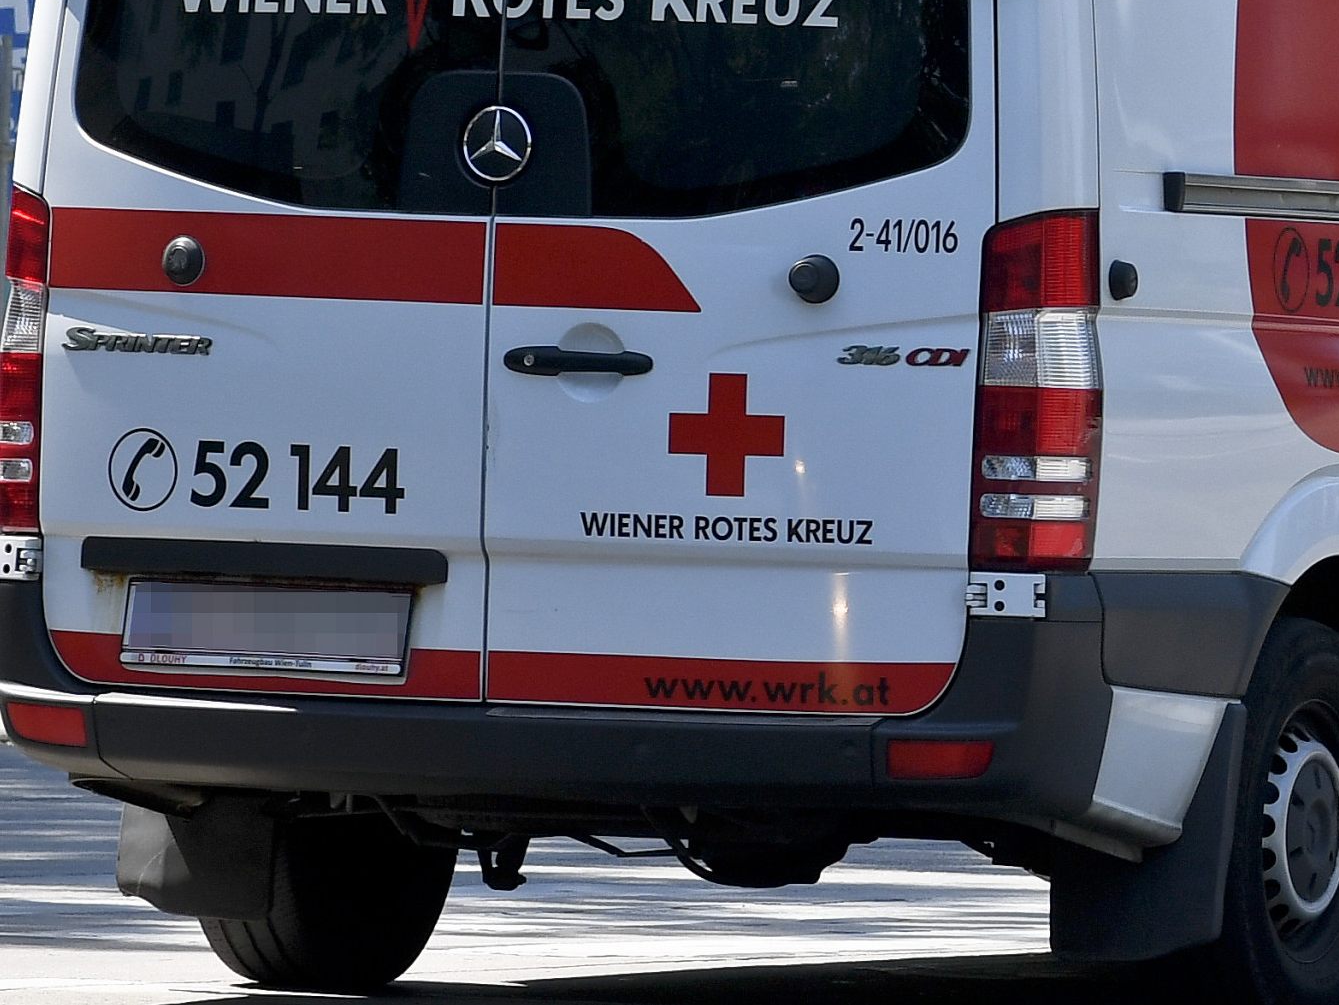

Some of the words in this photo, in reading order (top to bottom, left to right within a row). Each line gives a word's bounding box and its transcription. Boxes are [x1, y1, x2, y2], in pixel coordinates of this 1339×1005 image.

[848, 217, 959, 254] 2-41/016
[62, 326, 214, 356] SPRINTER
[836, 345, 900, 366] 316
[905, 347, 972, 367] CDI
[190, 440, 270, 509] 52
[290, 443, 406, 515] 144
[580, 511, 685, 540] WIENER
[694, 515, 778, 543] ROTES
[787, 518, 874, 545] KREUZ
[149, 653, 188, 664] DLOUHY
[229, 656, 273, 668] Fahrzeugbau
[644, 671, 890, 707] www.wrk.at
